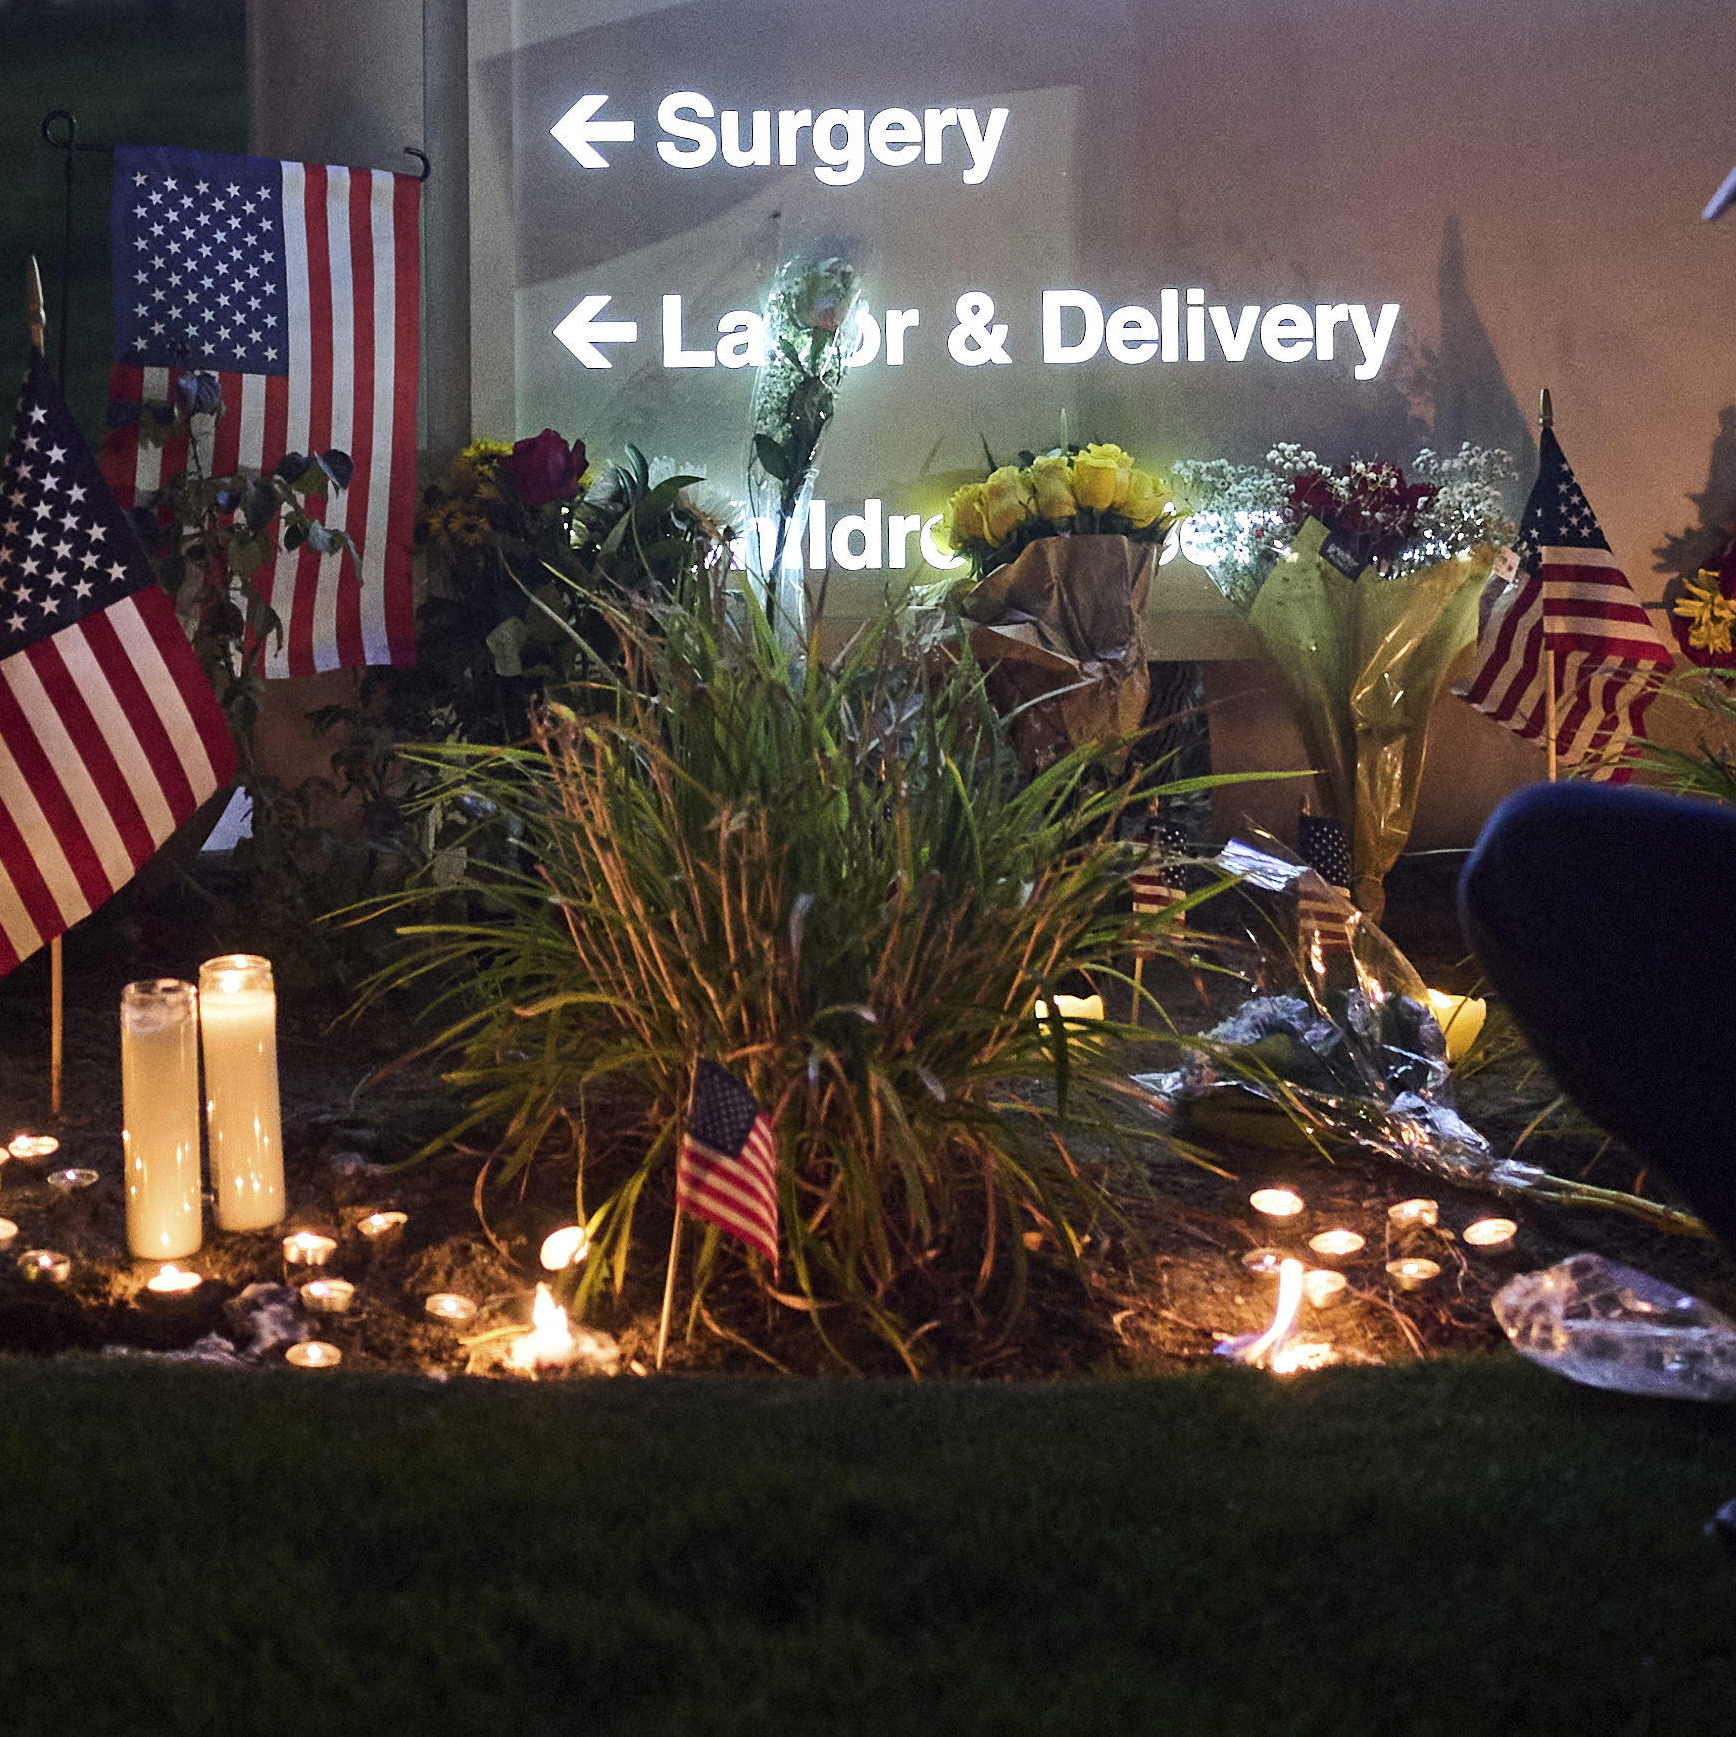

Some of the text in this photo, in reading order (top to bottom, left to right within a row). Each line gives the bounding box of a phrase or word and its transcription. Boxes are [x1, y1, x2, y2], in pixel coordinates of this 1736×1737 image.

[656, 91, 1009, 186] Surgery
[662, 288, 1400, 380] Laor & Delivery
